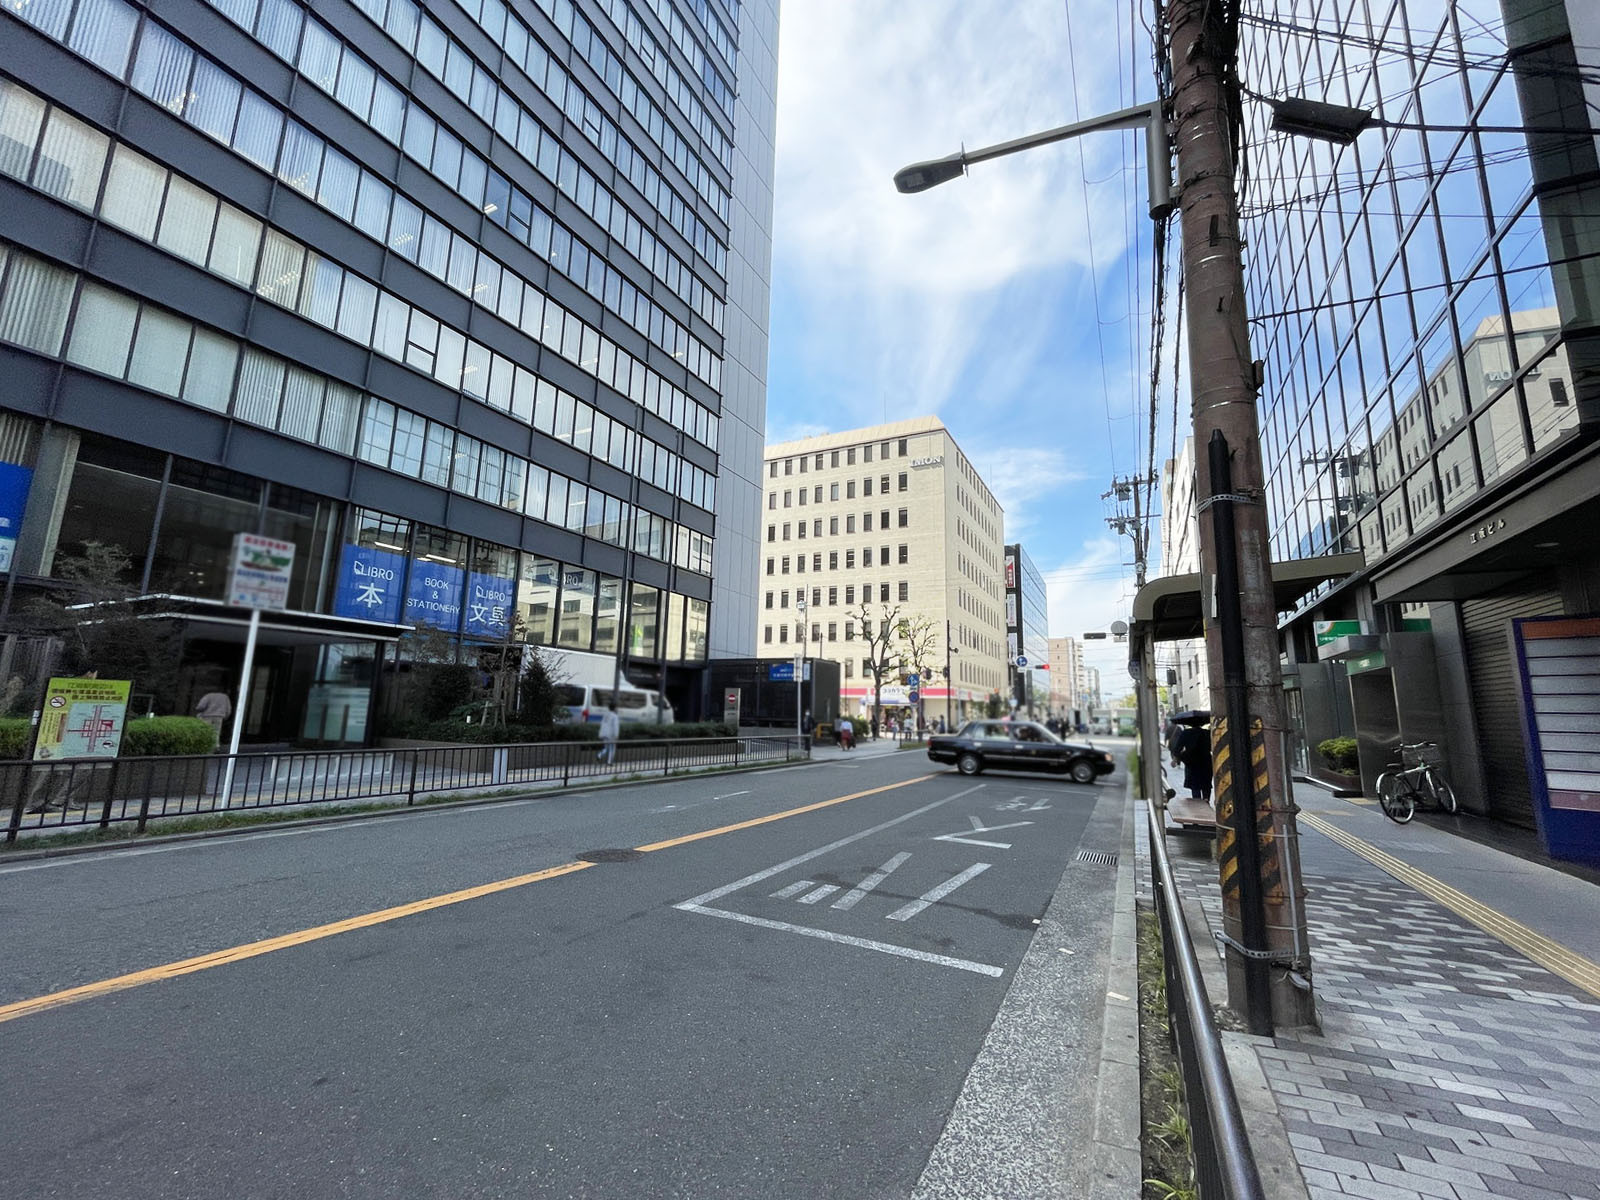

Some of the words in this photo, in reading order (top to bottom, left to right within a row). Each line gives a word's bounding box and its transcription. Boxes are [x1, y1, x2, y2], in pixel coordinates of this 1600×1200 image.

[357, 562, 394, 581] LIBRO
[424, 577, 449, 590] BOOK
[356, 583, 385, 608] 本
[432, 590, 439, 600] &
[478, 586, 505, 602] LIBRO
[407, 598, 461, 614] STATIONERY
[469, 603, 505, 626] 文具
